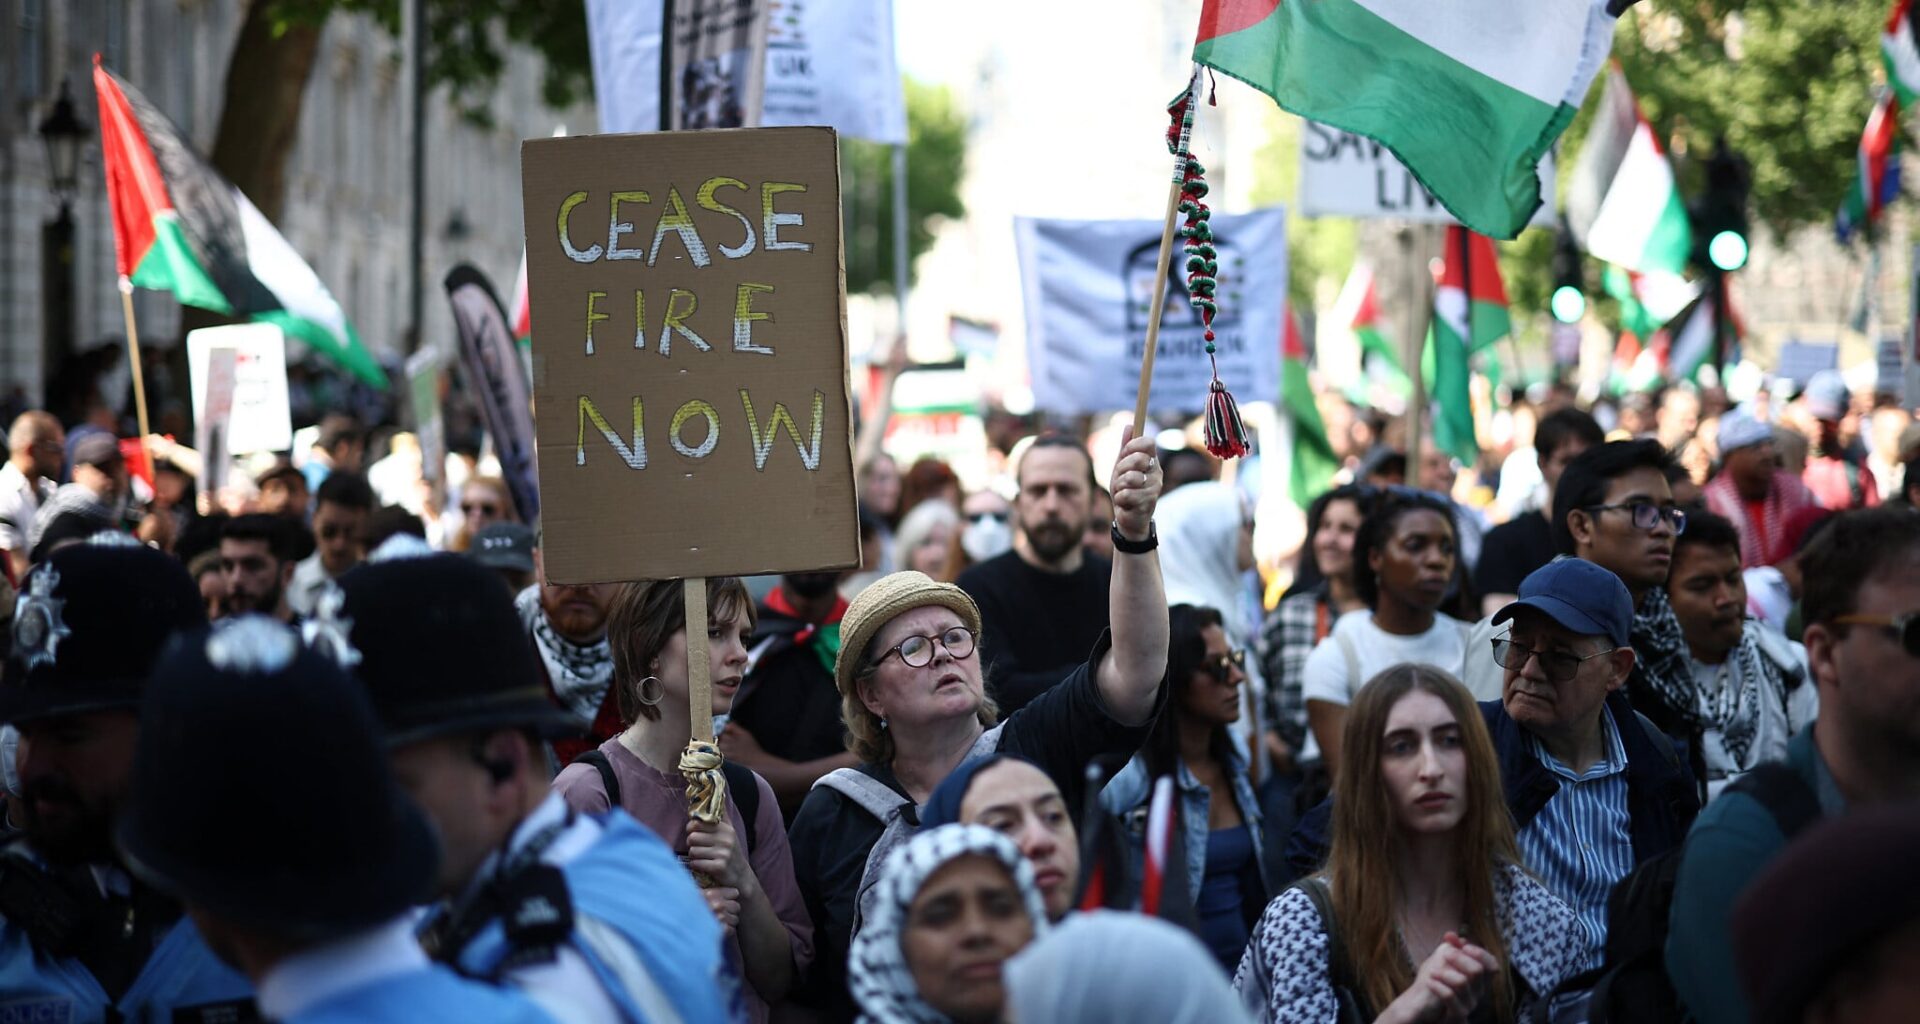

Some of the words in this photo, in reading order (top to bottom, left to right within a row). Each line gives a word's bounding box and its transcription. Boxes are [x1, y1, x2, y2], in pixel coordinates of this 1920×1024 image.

[556, 176, 814, 268] CEASE
[584, 283, 777, 358] FIRE
[575, 388, 826, 472] NOW
[0, 1003, 68, 1024] OLICE
